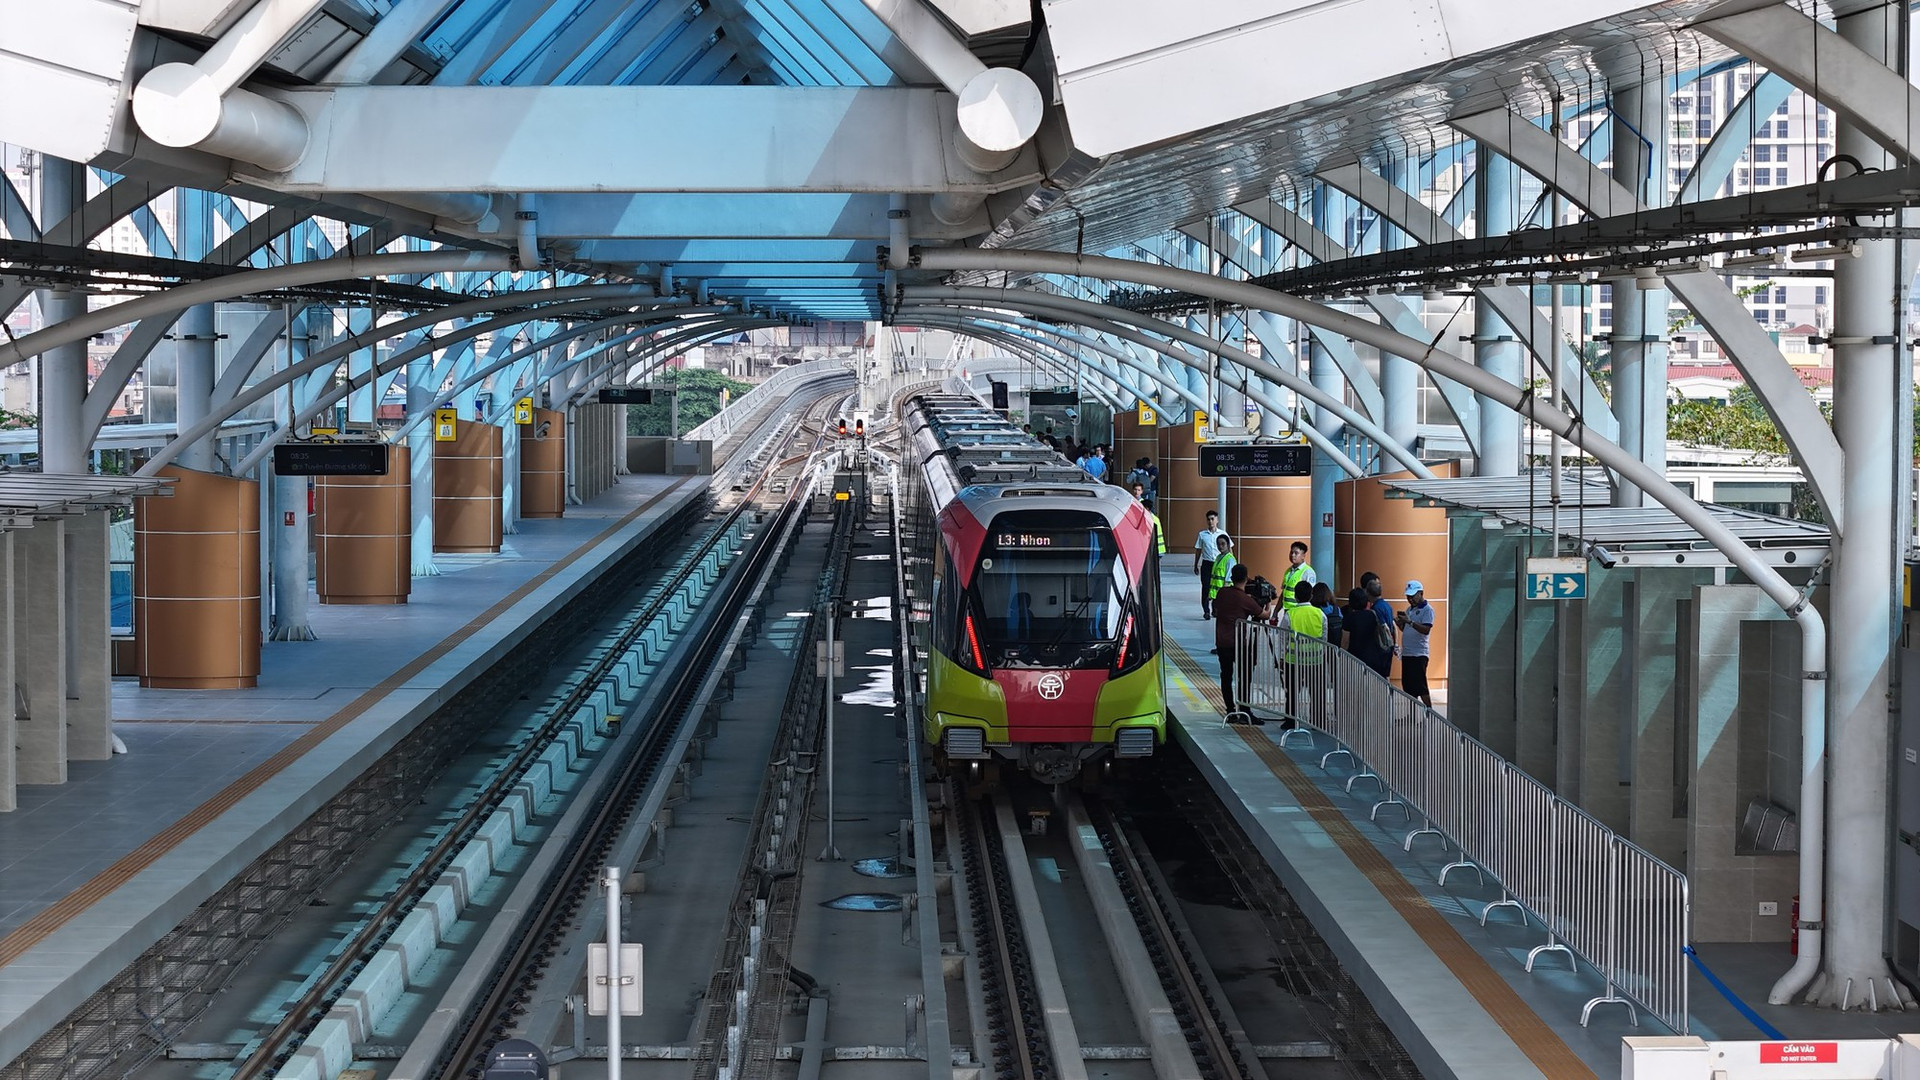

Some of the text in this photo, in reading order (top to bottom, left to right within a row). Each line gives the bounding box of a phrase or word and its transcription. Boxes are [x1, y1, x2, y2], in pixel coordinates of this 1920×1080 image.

[998, 534, 1051, 545] L3: Nhon
[1783, 1044, 1815, 1053] CẤM VÀO
